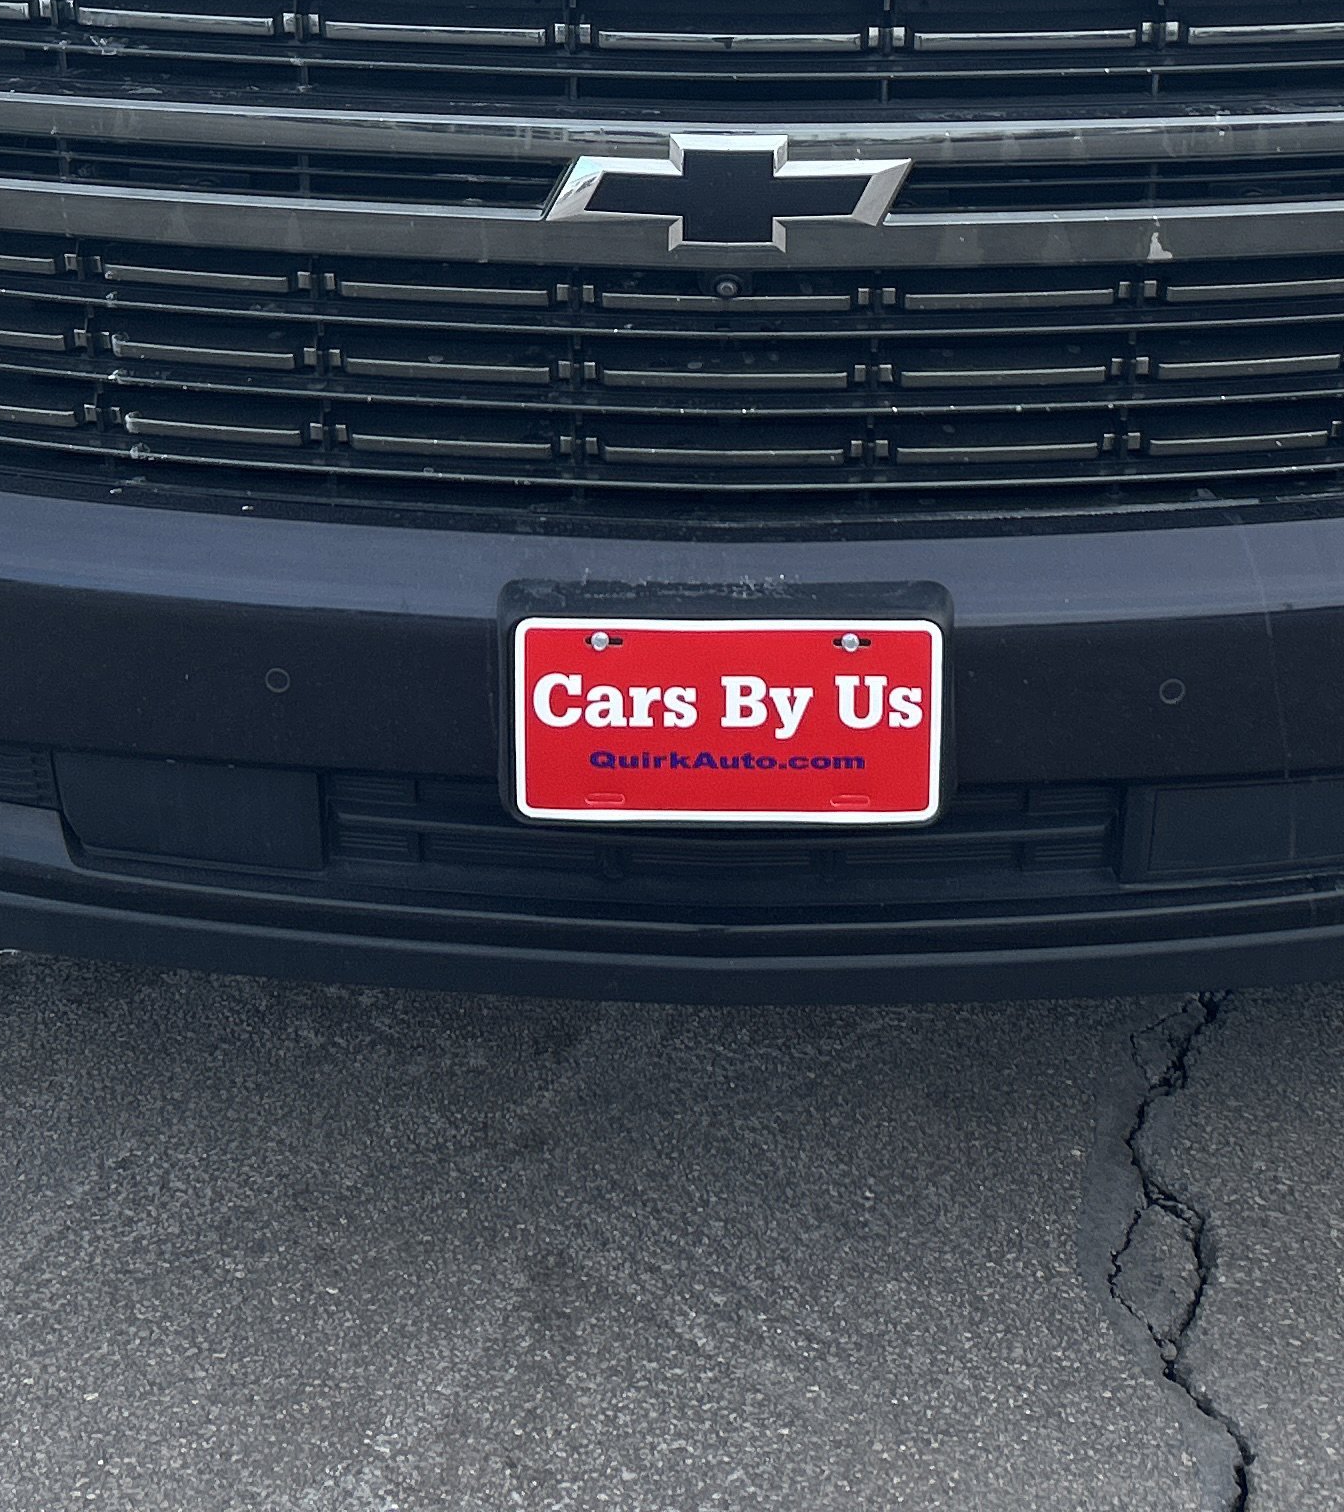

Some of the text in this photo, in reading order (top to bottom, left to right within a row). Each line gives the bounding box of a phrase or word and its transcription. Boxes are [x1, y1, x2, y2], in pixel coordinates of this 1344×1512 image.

[532, 672, 923, 740] Cars By Us
[588, 751, 866, 770] QuirkAuto.com
